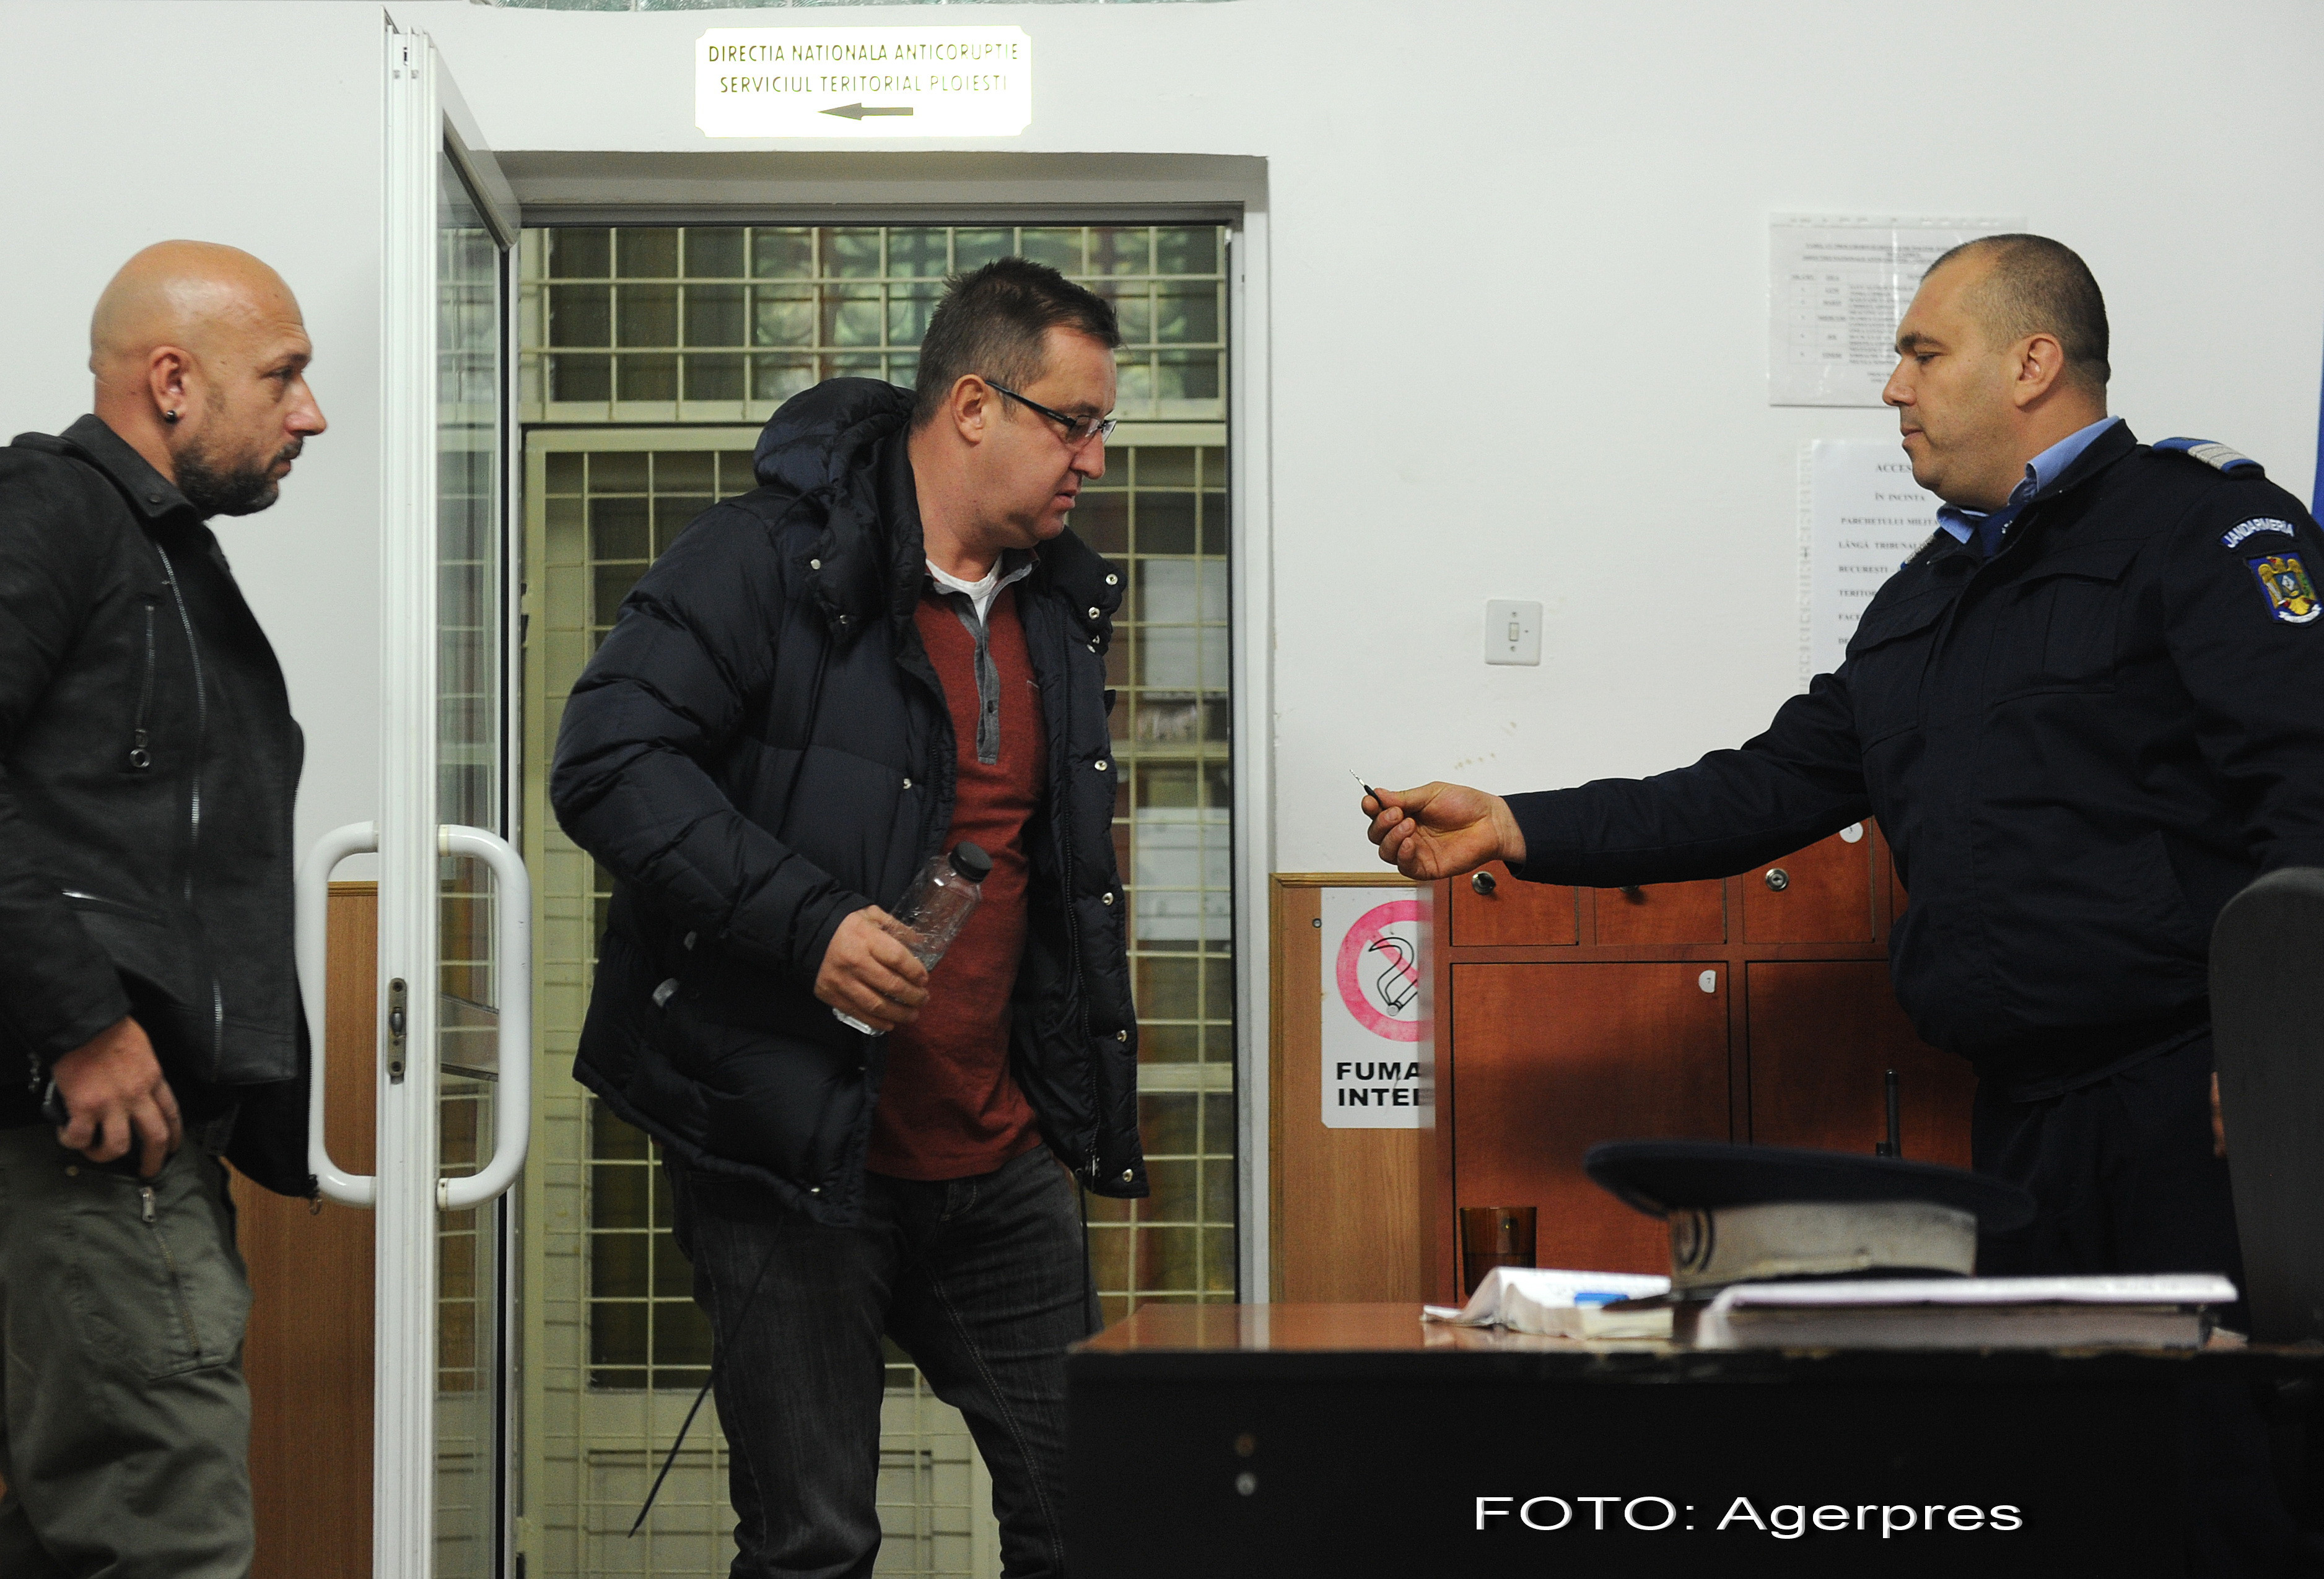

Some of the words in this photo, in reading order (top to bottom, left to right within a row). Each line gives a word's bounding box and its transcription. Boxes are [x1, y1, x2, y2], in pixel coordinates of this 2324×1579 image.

[709, 45, 785, 62] DIRECTIA
[792, 44, 888, 61] NATIONALA
[894, 43, 1018, 60] ANTICORUPTIE
[720, 76, 812, 93] SERVICIUL
[820, 76, 922, 92] TERITORIAL
[930, 74, 1007, 91] PLOIESTI
[2224, 518, 2294, 548] JANDARMERIA
